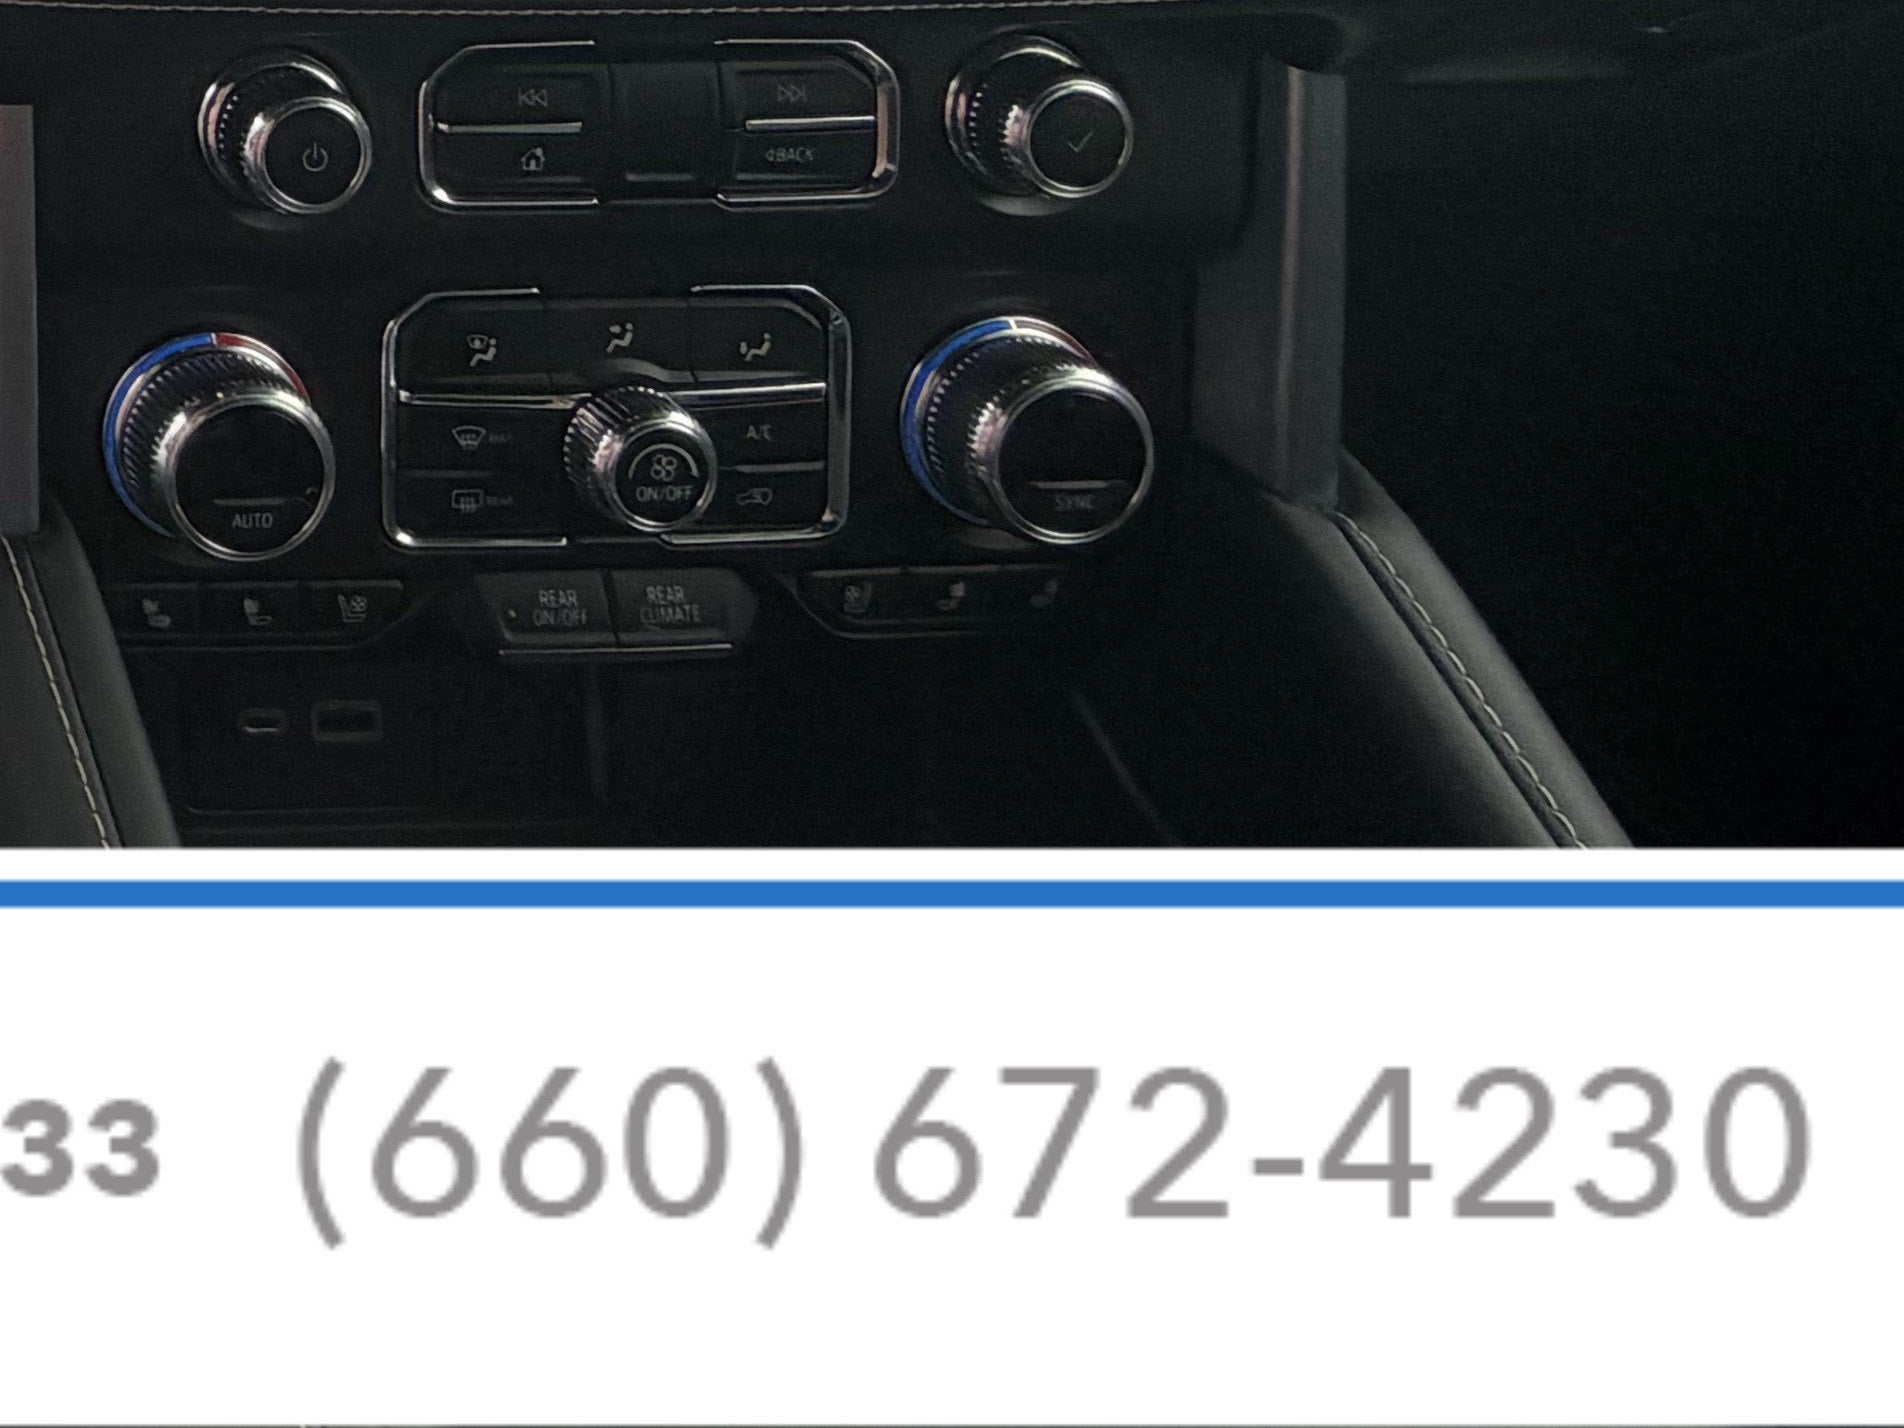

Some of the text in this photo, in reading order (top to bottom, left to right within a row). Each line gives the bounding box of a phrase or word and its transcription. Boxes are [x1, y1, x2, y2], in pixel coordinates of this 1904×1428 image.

[776, 146, 815, 163] BACK
[745, 423, 774, 442] A/C
[635, 484, 694, 503] ON/OFF
[231, 511, 274, 530] AUTO
[538, 589, 579, 607] REAR
[645, 584, 686, 605] REAR
